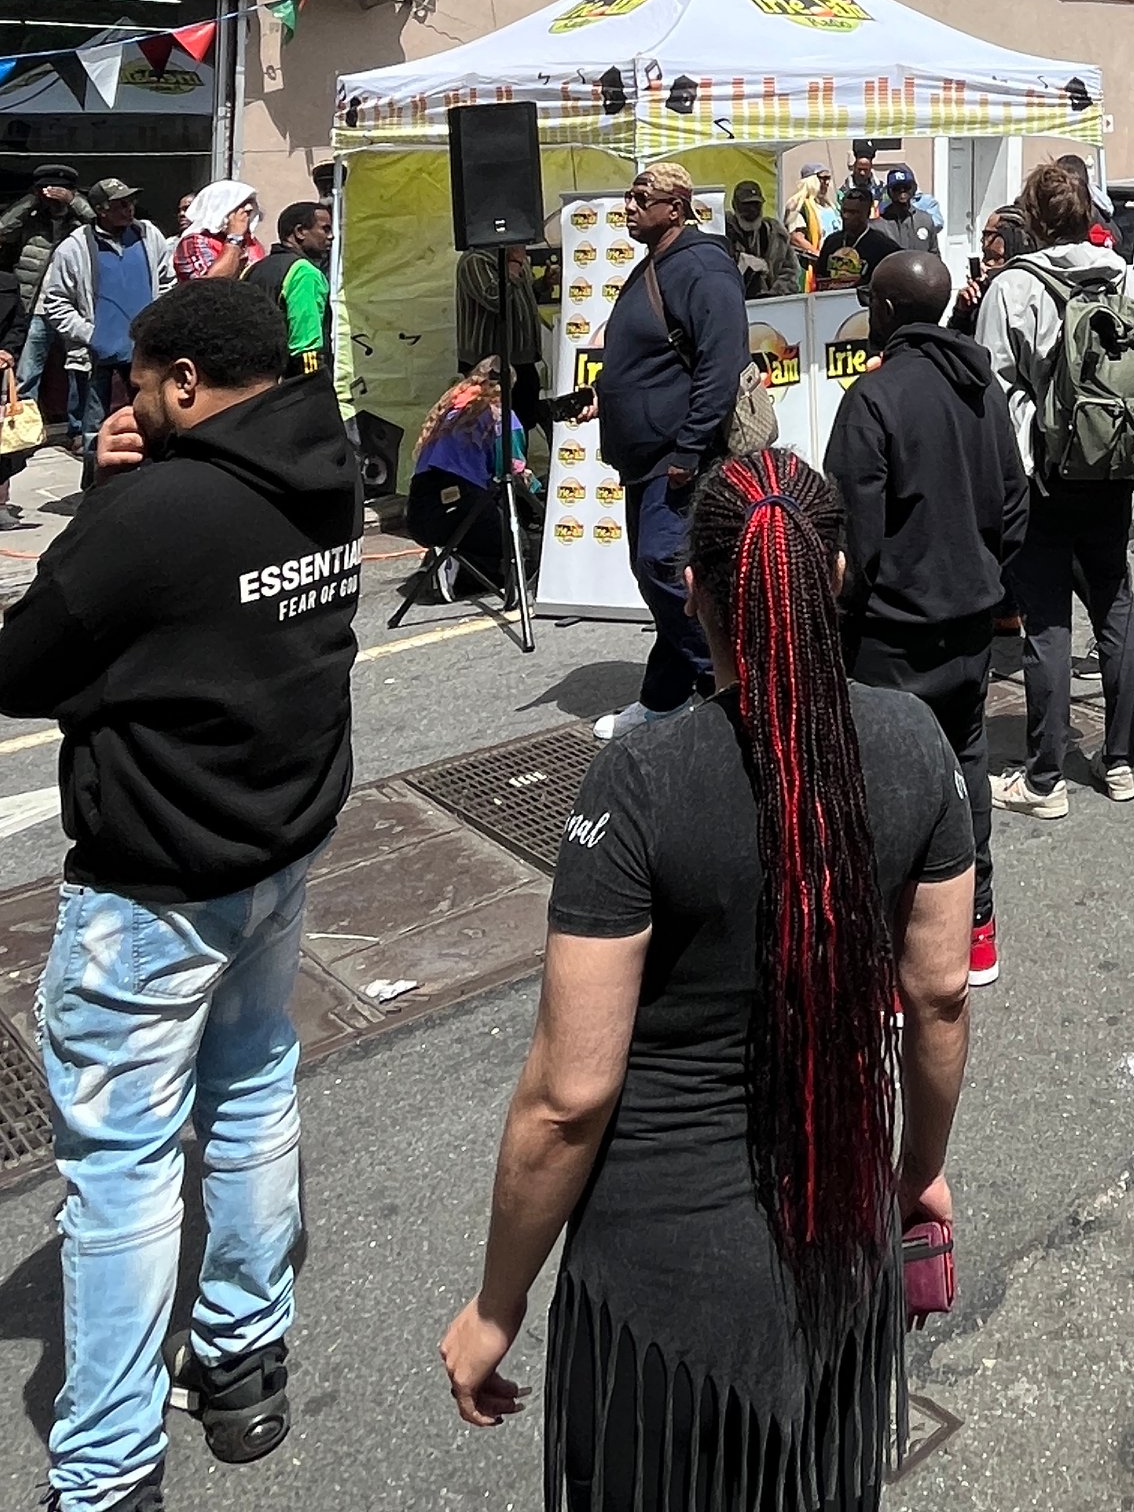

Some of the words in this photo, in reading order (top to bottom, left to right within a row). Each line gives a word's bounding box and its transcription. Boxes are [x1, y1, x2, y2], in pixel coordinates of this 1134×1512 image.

[828, 344, 867, 377] Irie
[278, 589, 317, 622] FEAR
[320, 582, 337, 605] OF
[339, 574, 358, 598] GOD
